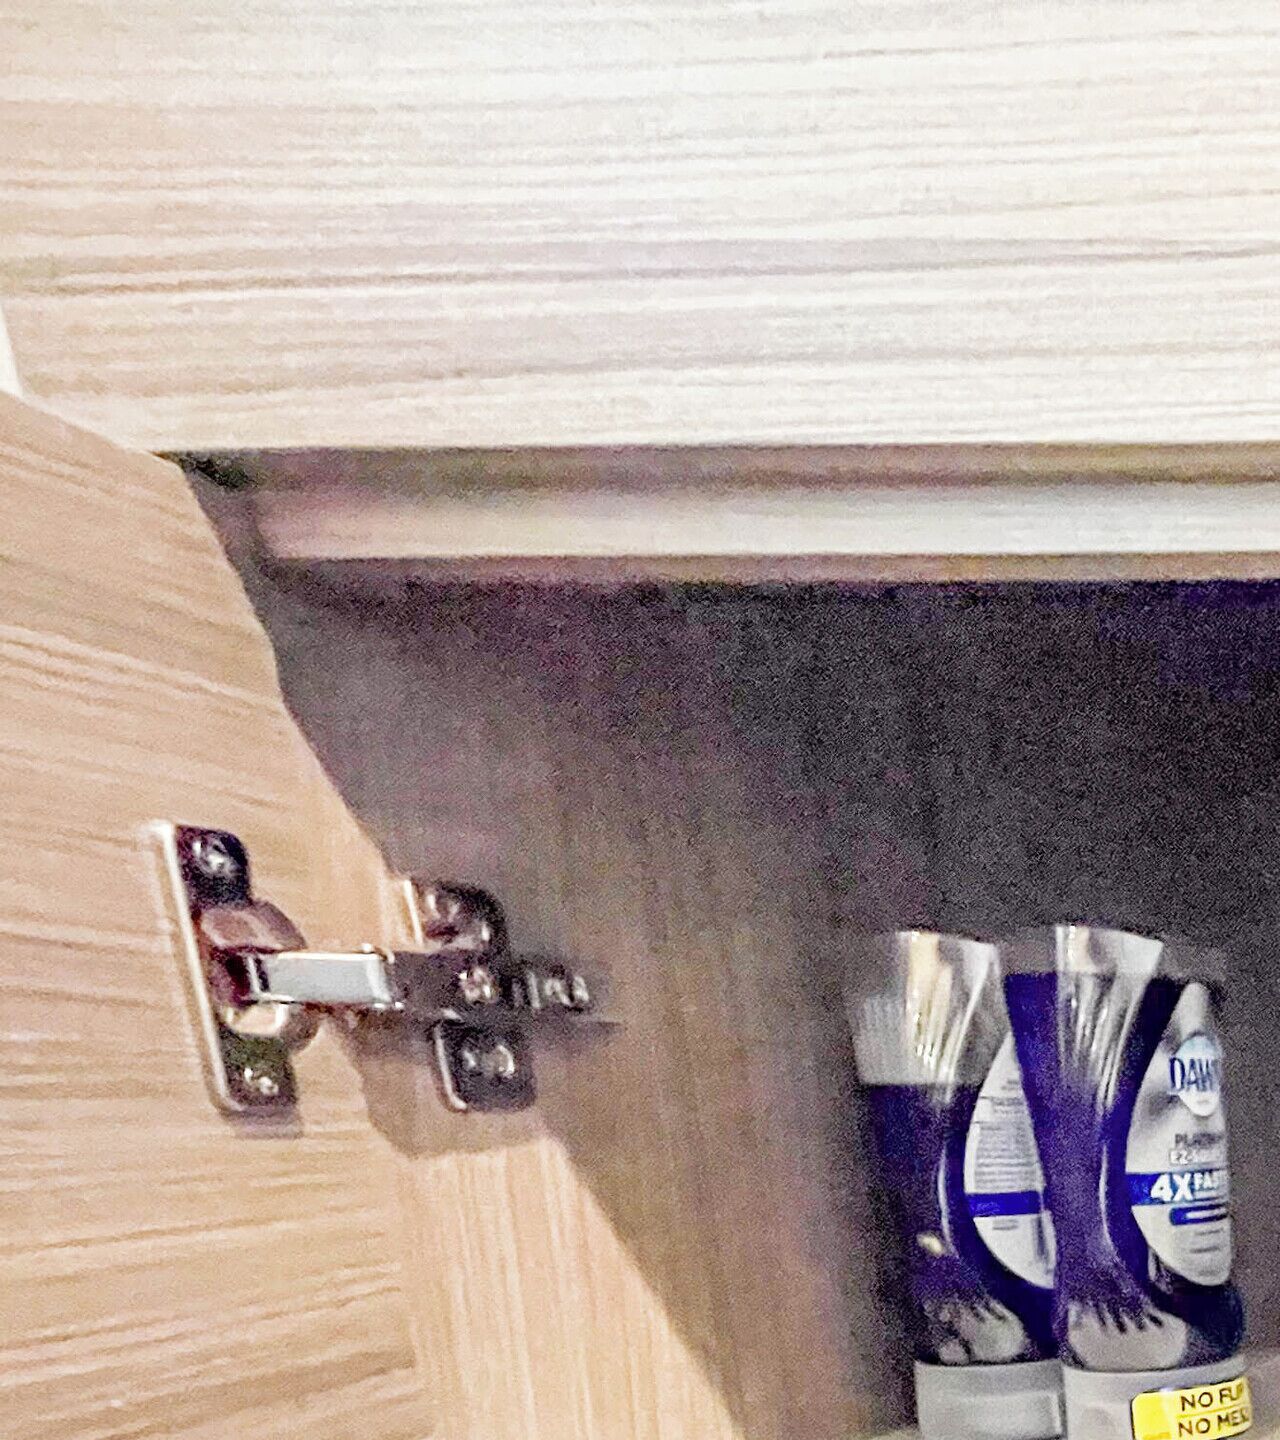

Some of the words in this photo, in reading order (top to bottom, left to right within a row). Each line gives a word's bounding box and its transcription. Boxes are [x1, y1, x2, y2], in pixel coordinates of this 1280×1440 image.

[1151, 1172, 1193, 1201] 4X
[1180, 1391, 1214, 1412] NO
[1177, 1418, 1211, 1438] NO
